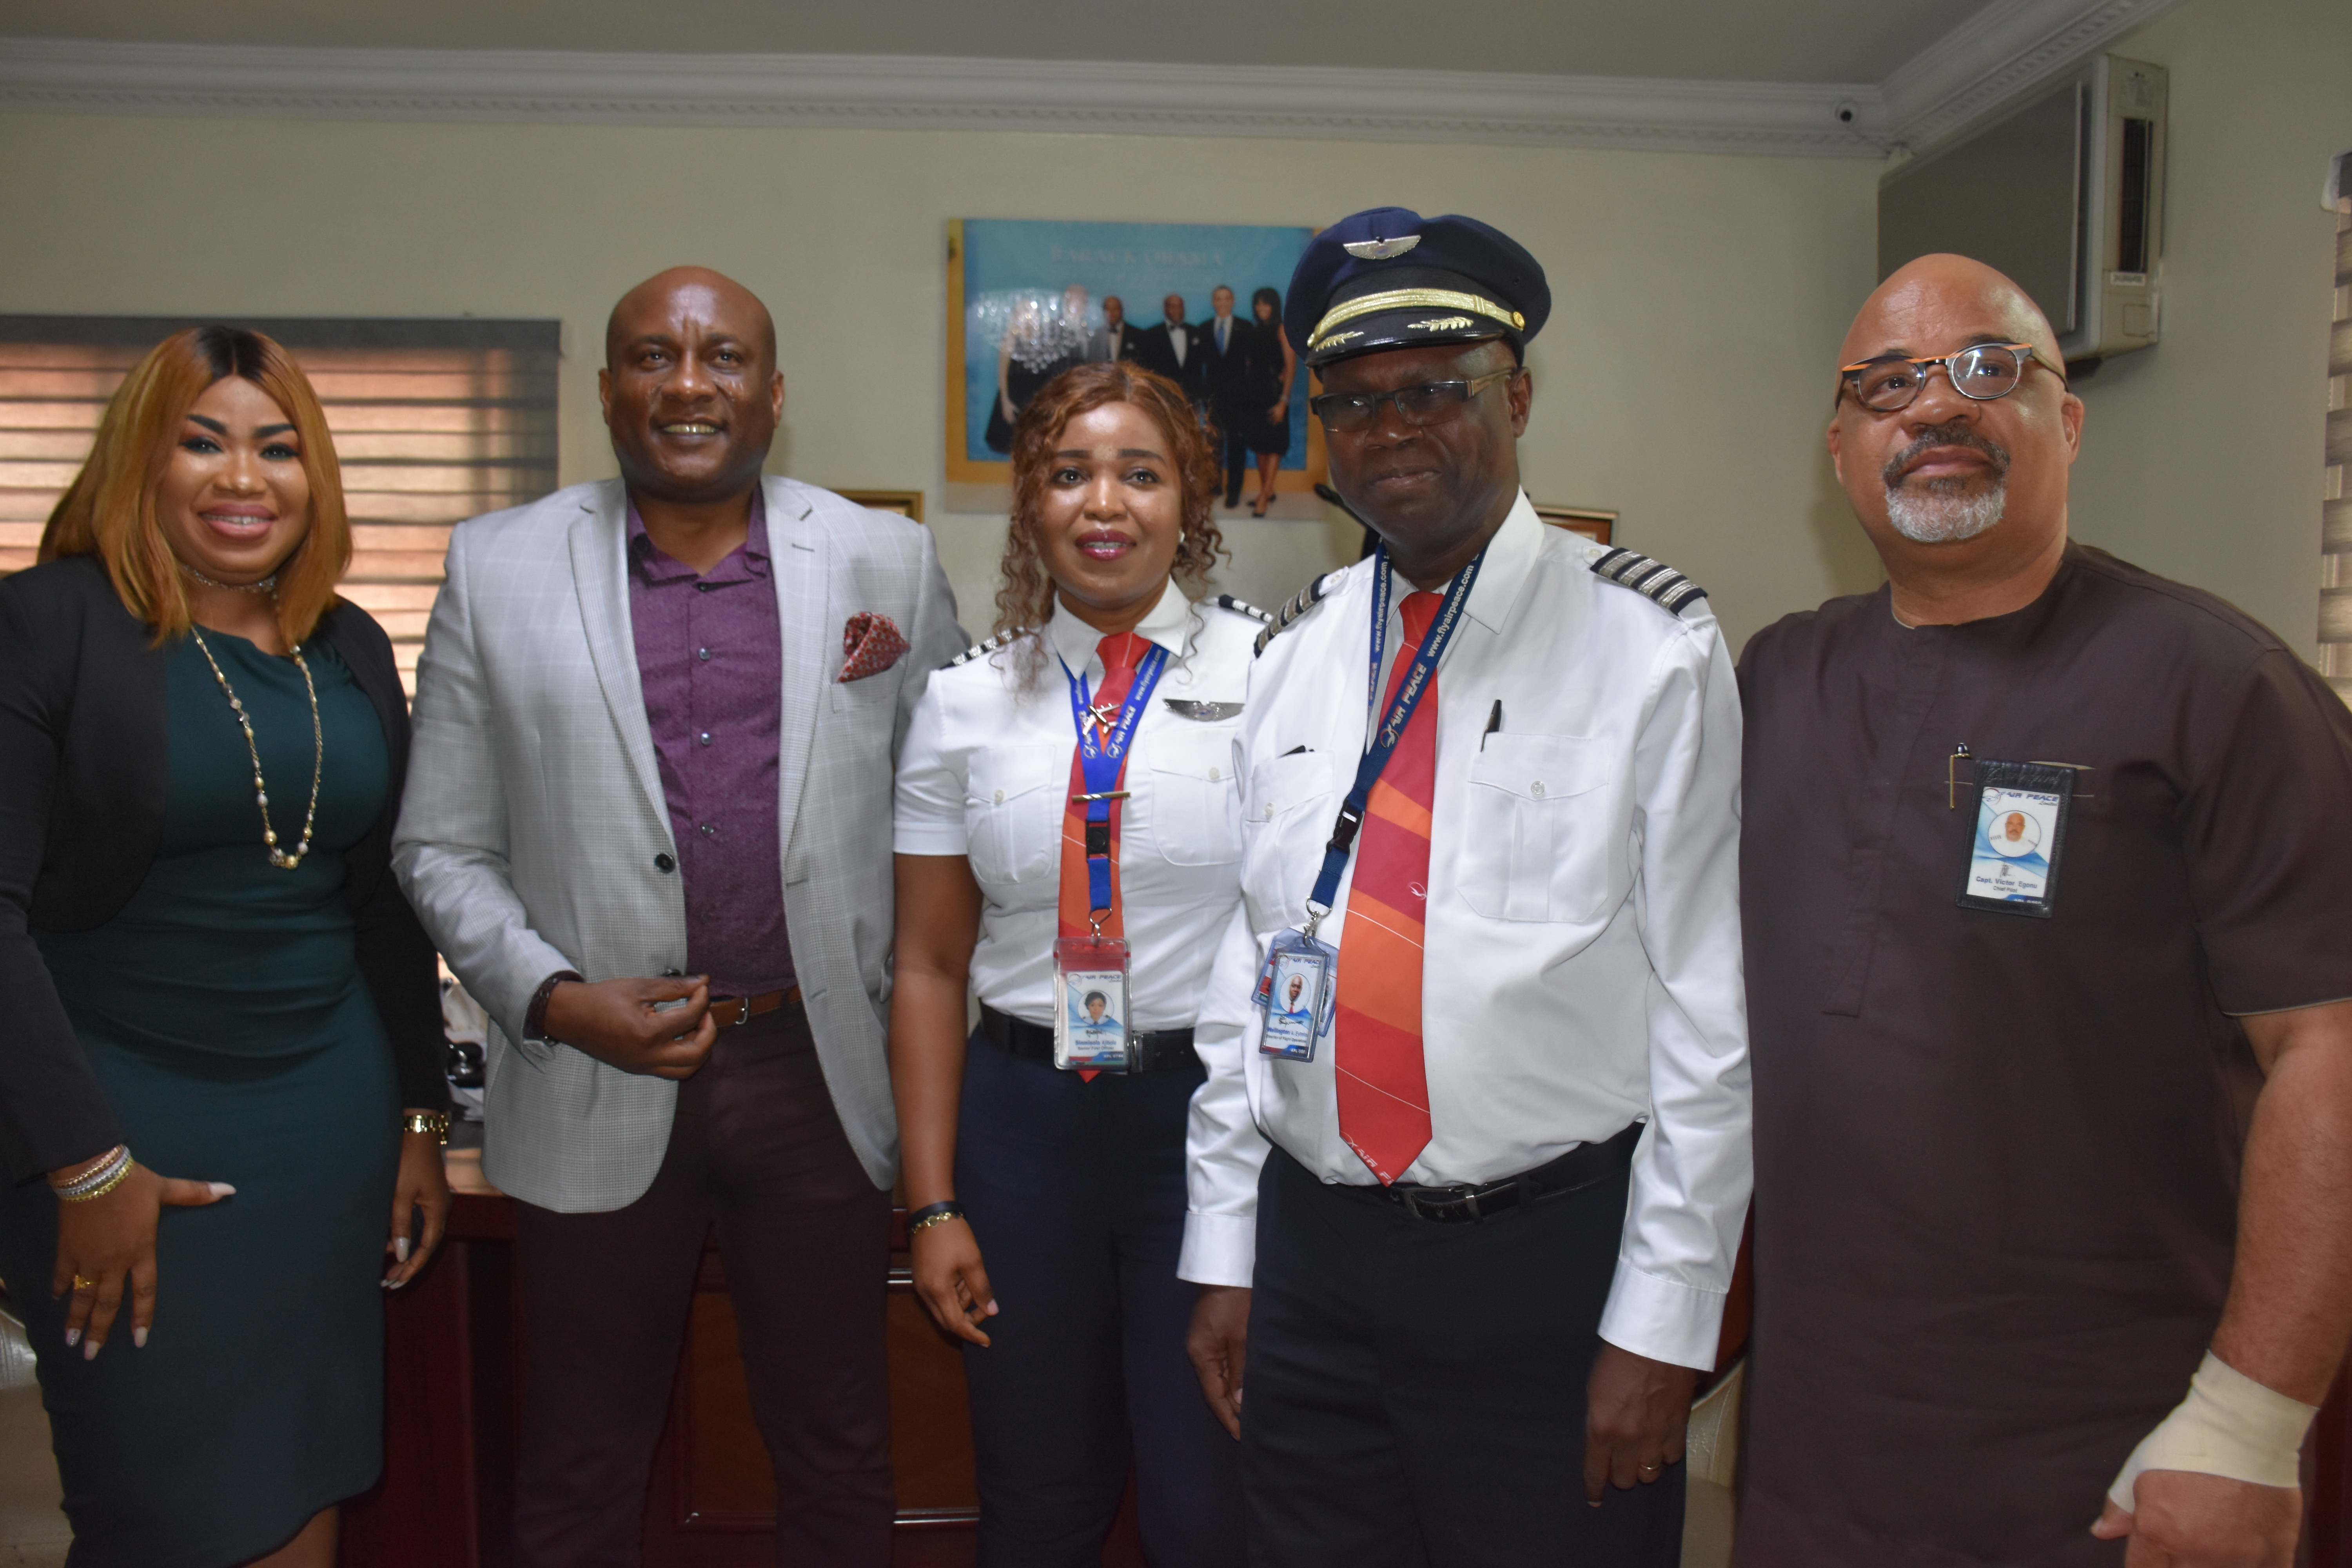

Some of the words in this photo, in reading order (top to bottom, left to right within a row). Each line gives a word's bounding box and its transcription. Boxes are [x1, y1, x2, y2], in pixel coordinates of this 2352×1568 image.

[1375, 561, 1388, 653] www.flyairpeace.com
[1427, 565, 1474, 657] www.flyairpeace.com
[1390, 706, 1406, 727] AIR
[1401, 662, 1427, 704] PEACE
[1357, 1149, 1378, 1167] AIR
